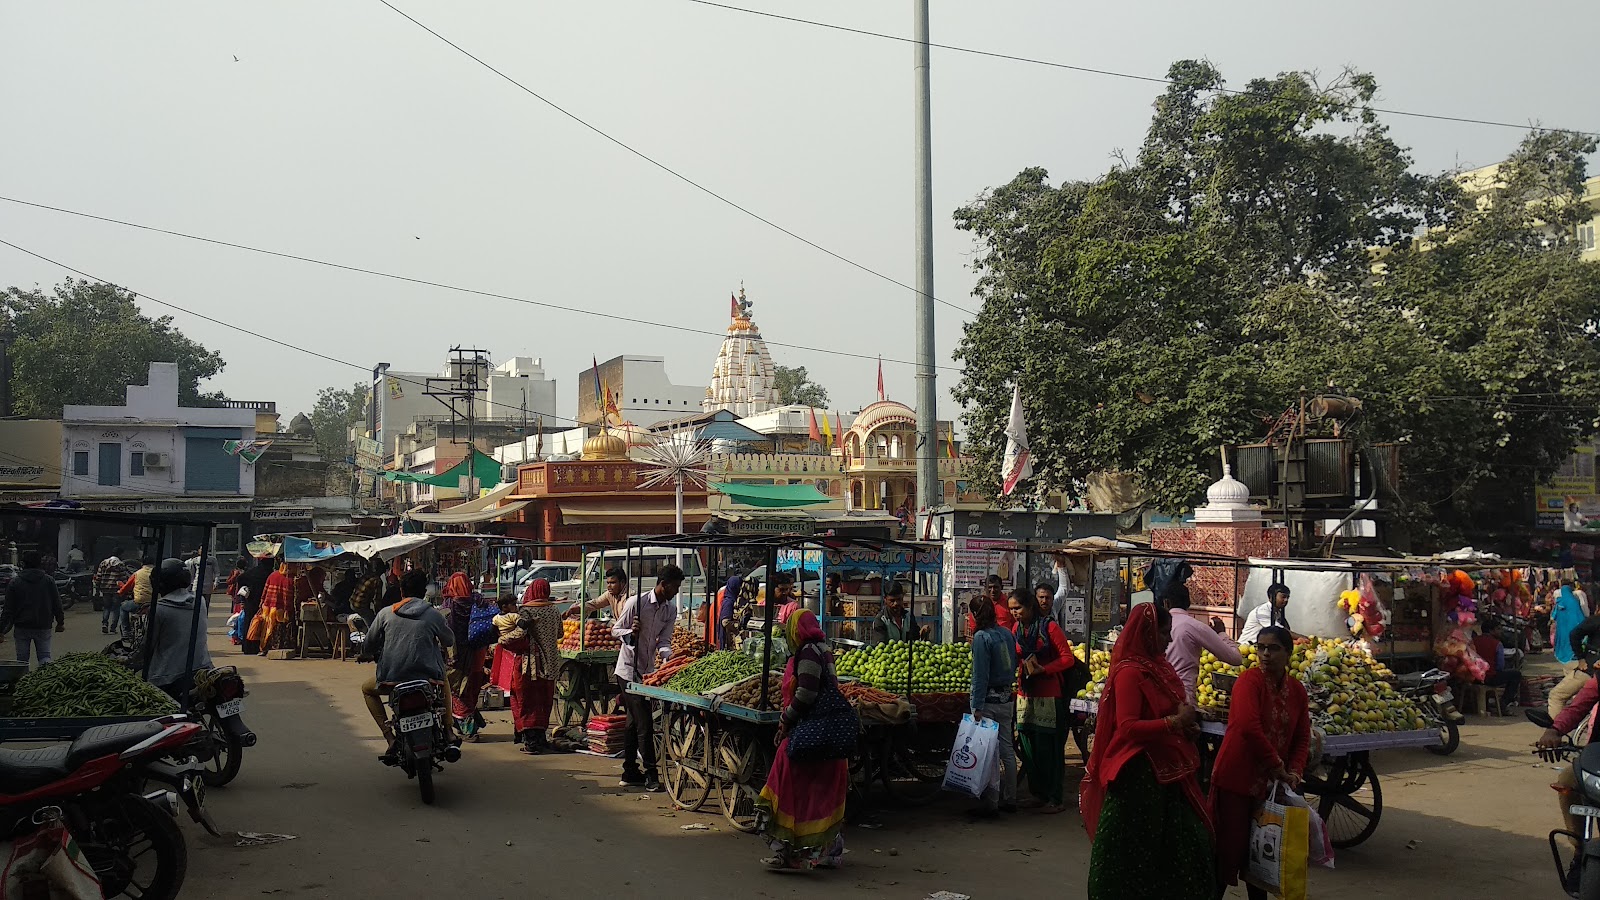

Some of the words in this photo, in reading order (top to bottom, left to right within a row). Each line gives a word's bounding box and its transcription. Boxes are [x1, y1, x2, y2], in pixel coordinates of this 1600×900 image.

[764, 521, 788, 531] पायल
[788, 520, 806, 531] स्टोर
[402, 719, 431, 731] 9577
